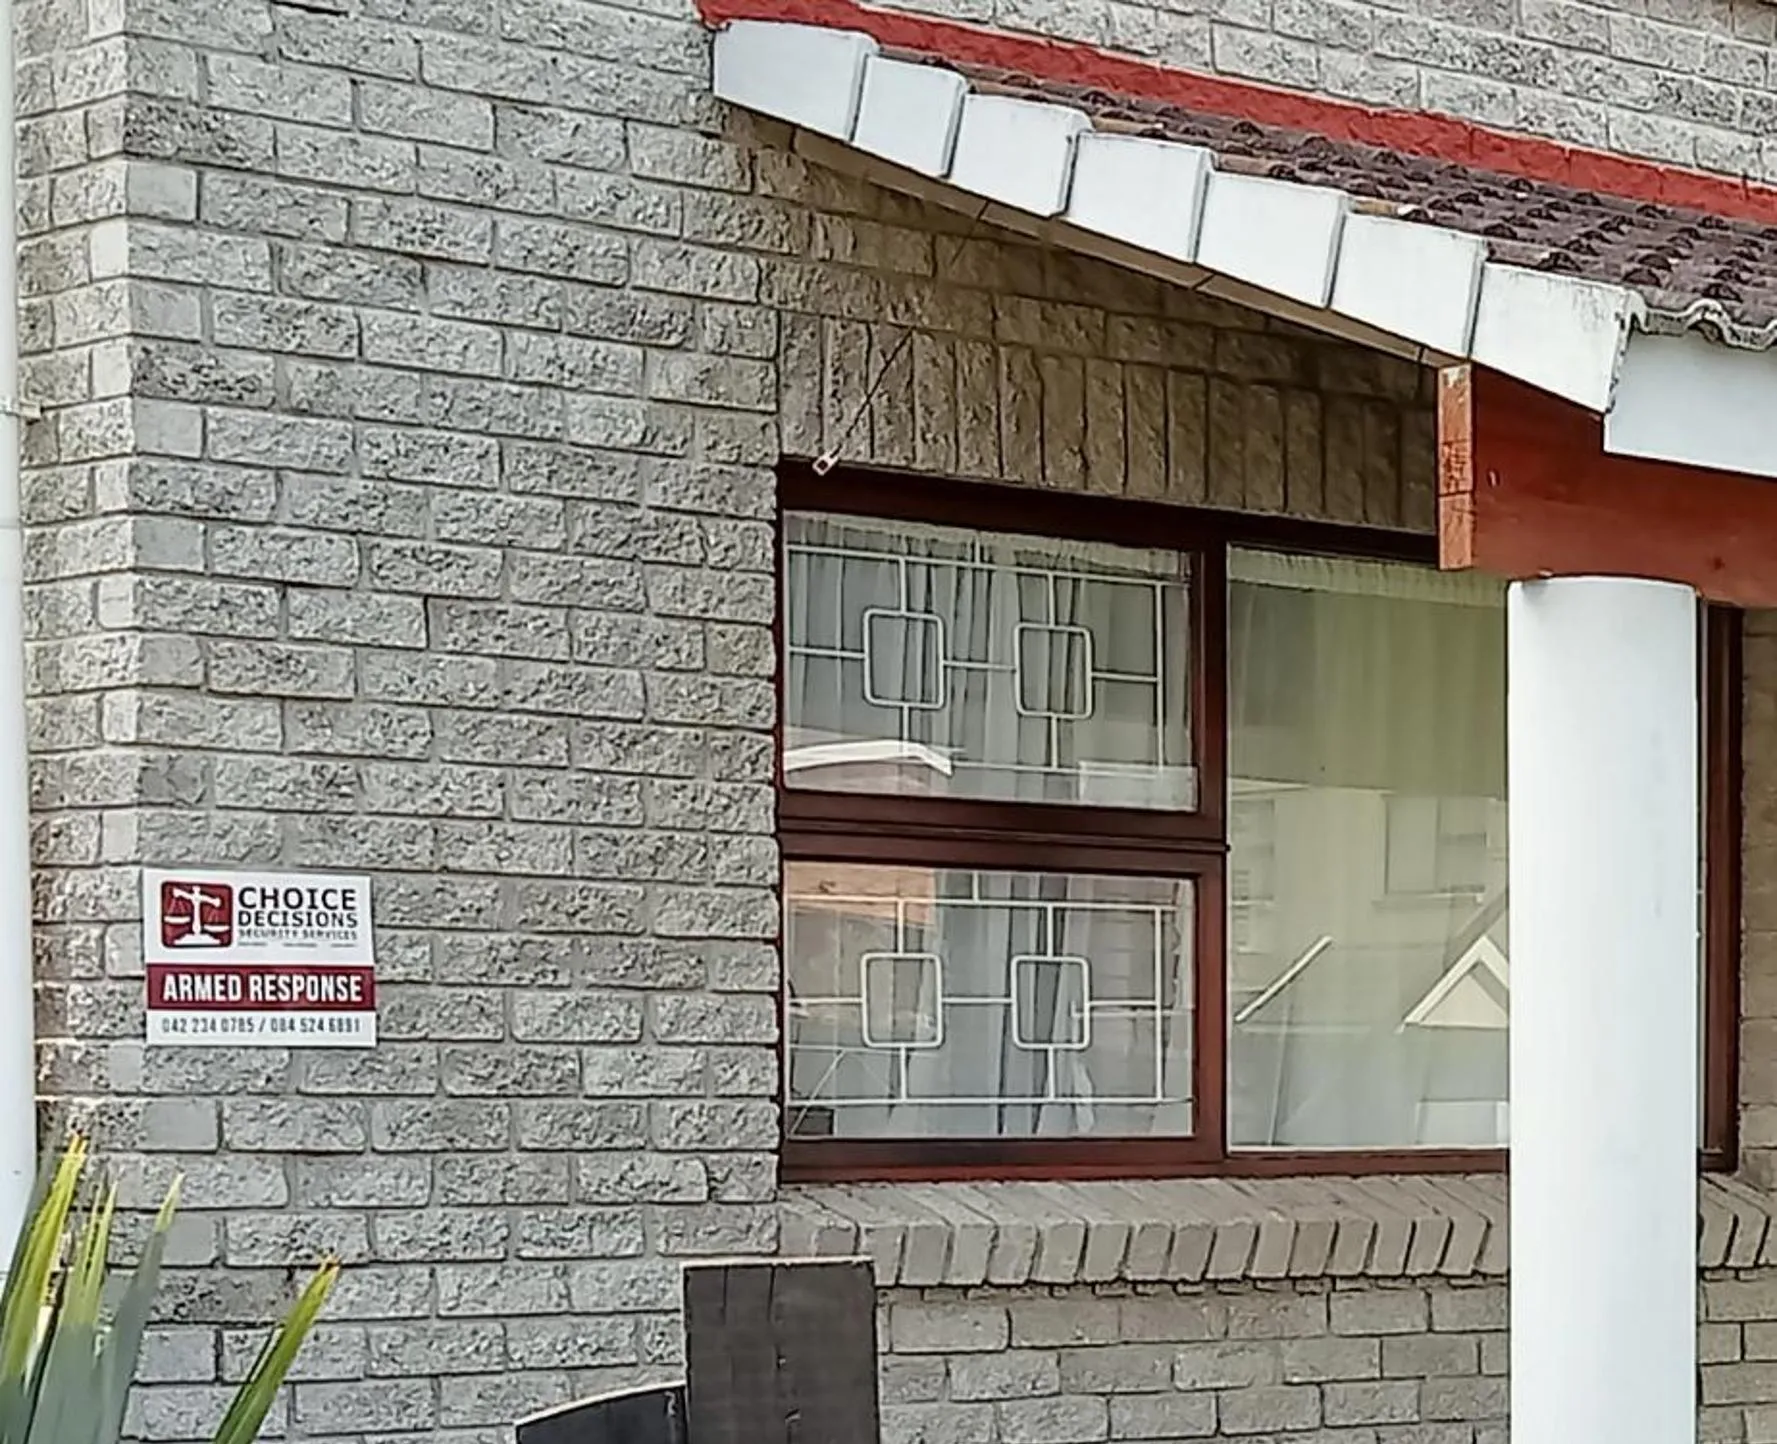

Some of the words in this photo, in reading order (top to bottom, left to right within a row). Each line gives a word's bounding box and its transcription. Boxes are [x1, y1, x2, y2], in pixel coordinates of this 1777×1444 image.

[239, 887, 357, 910] CHOICE
[238, 911, 358, 928] DECISIONS
[238, 928, 298, 939] SECURITY
[302, 930, 358, 940] SERVICES
[164, 974, 242, 1001] ARMED
[250, 975, 363, 1002] RESPONSE
[162, 1018, 187, 1032] 042
[259, 1018, 266, 1032] /
[300, 1018, 324, 1033] 524
